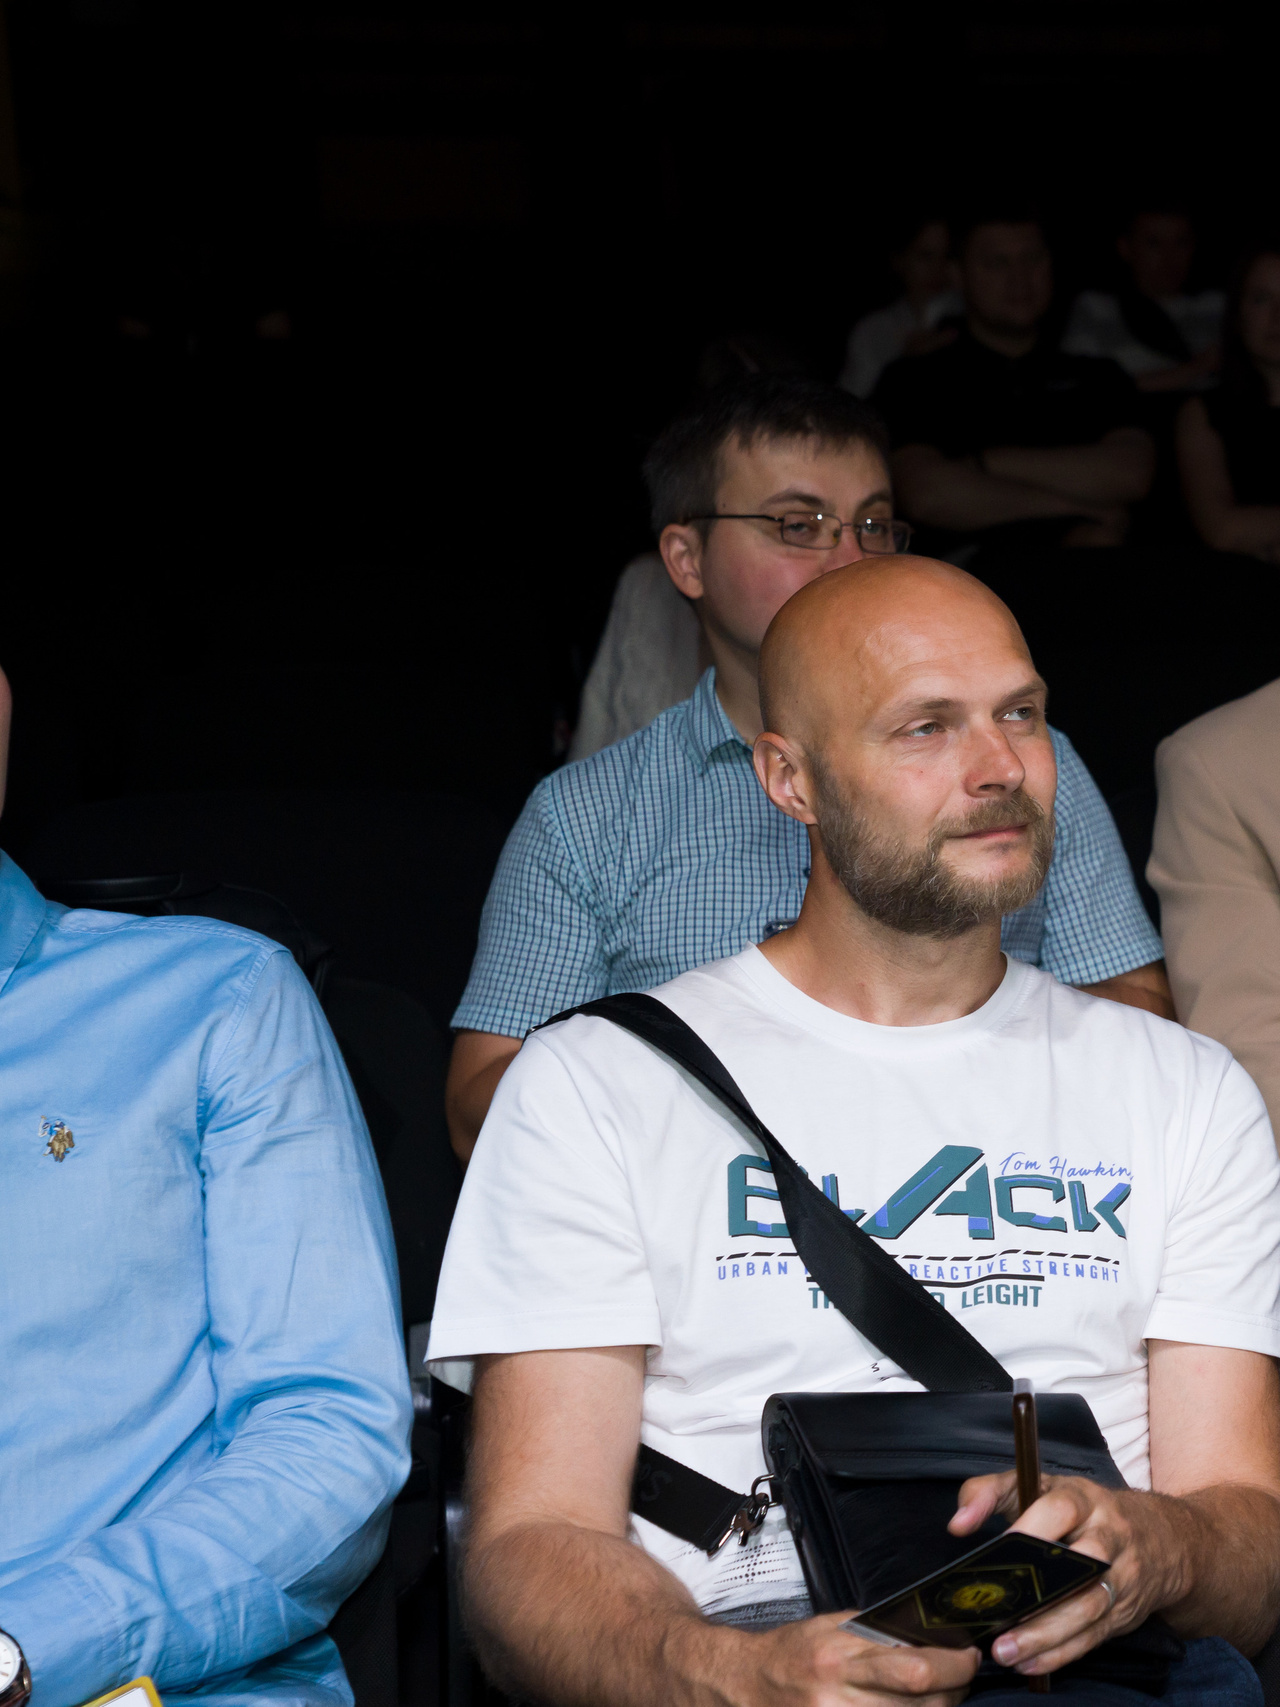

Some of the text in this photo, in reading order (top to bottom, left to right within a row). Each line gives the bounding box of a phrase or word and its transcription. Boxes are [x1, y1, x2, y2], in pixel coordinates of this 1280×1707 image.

[1000, 1152, 1042, 1176] Tom
[718, 1261, 789, 1280] URBAN
[909, 1259, 1008, 1281] REACTIVE
[1022, 1259, 1119, 1283] STRENGHT
[961, 1283, 1043, 1309] LEIGHT
